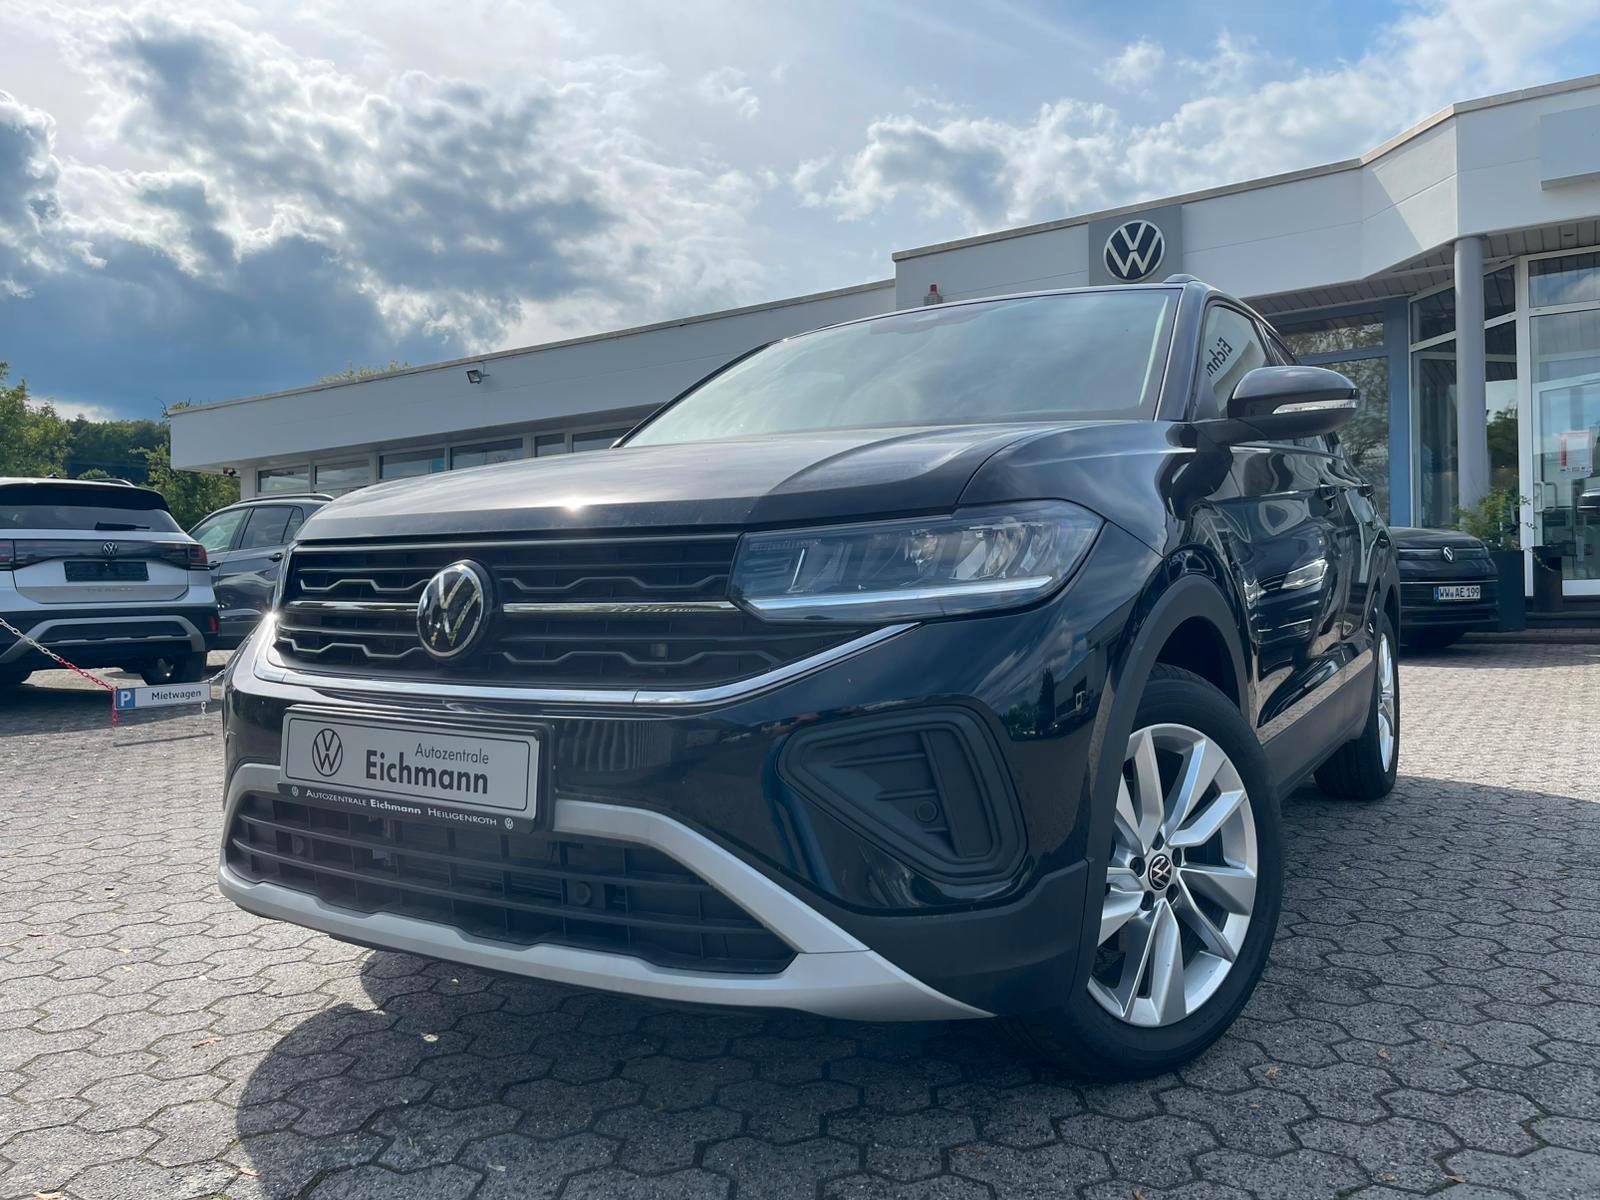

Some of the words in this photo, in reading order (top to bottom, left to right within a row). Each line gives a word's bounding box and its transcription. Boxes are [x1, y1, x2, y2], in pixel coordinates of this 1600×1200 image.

[1467, 587, 1479, 597] 199
[120, 691, 131, 707] P
[151, 690, 201, 700] Mietwagen
[415, 742, 489, 765] Autozentrale
[365, 749, 489, 794] Eichmann
[306, 789, 366, 806] AUTOZENTRALE
[369, 798, 421, 815] Eichmann
[427, 807, 497, 826] HEILIGENROTH
